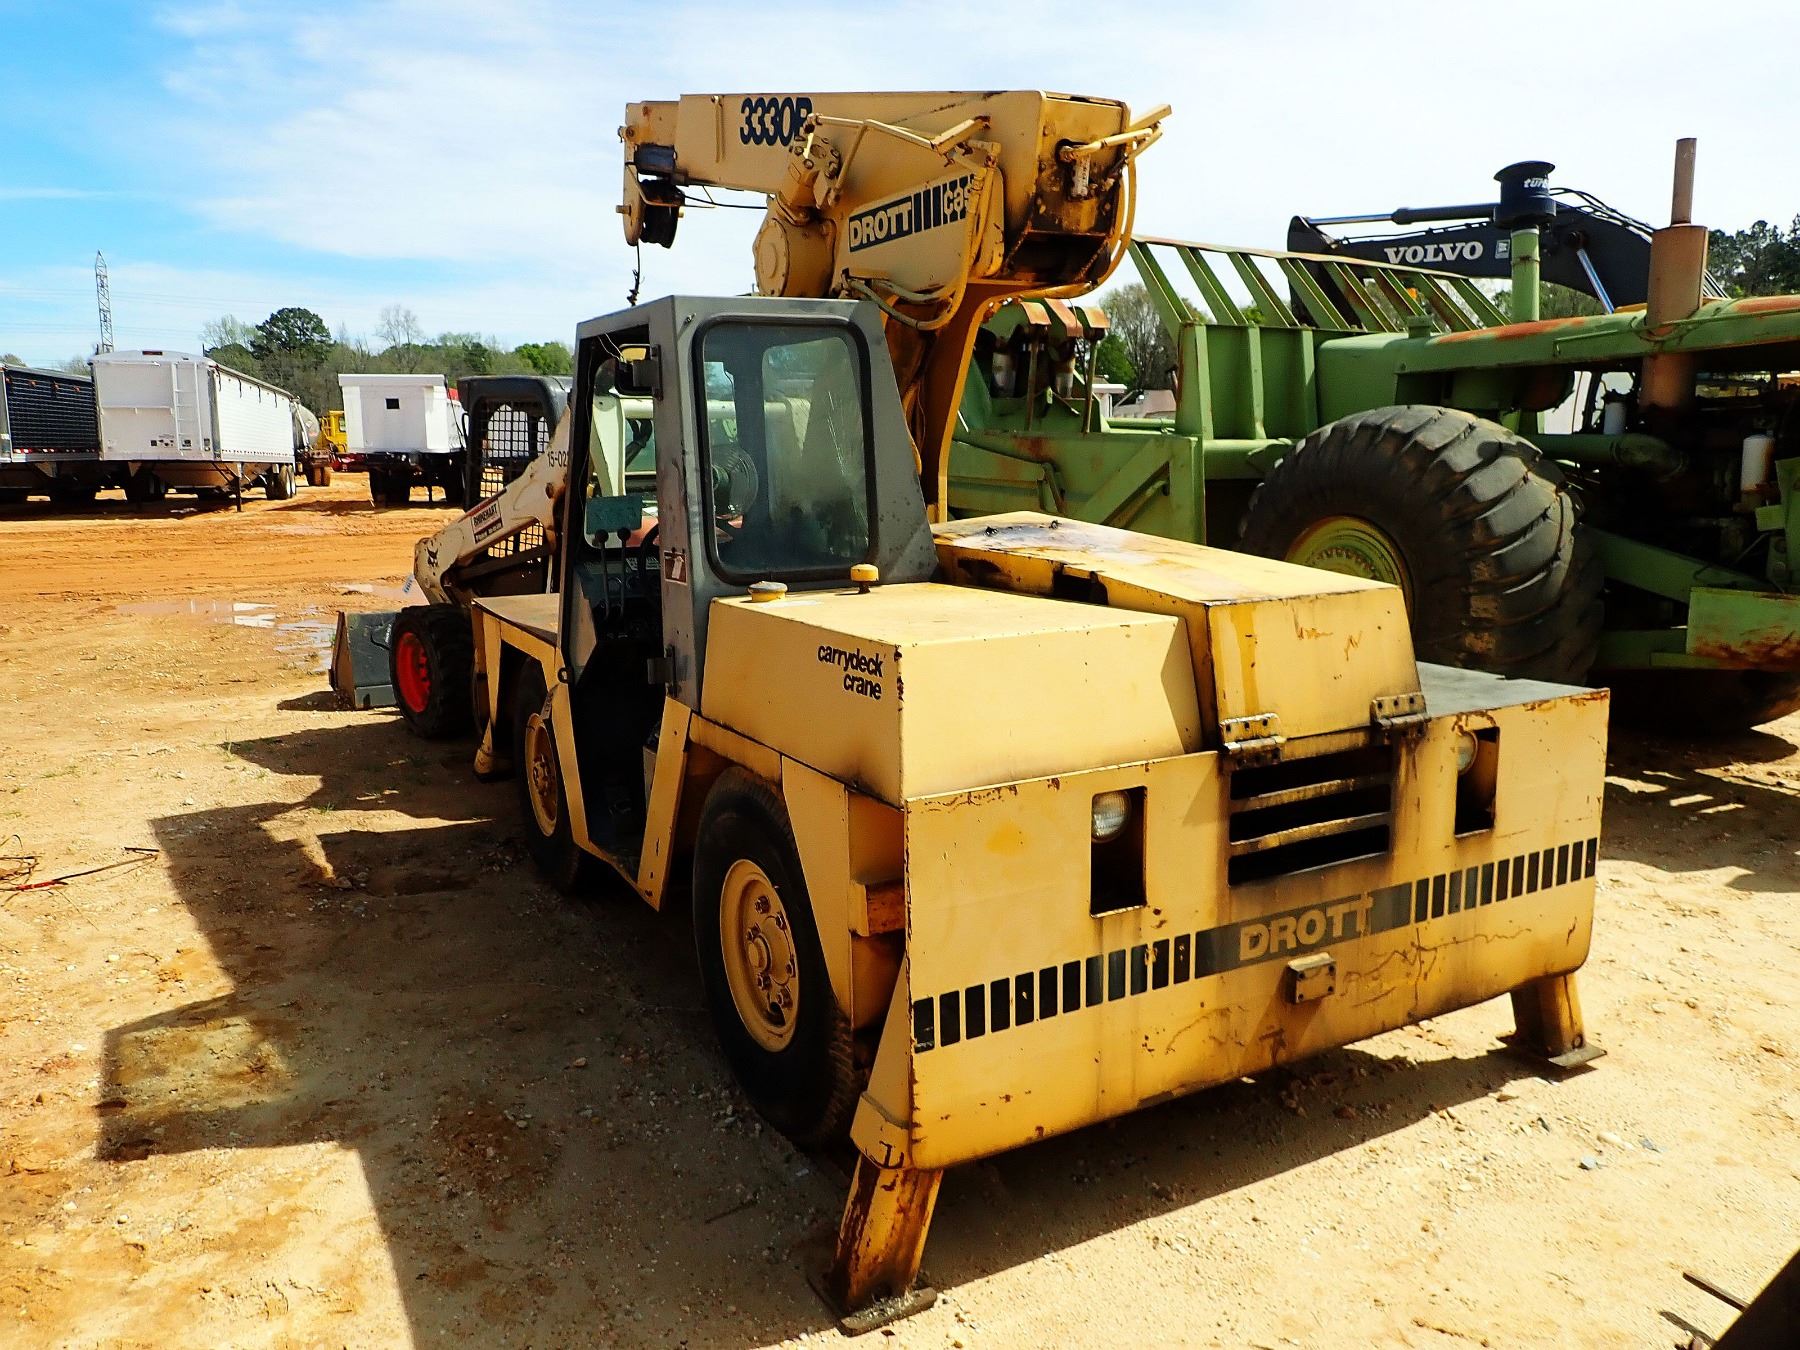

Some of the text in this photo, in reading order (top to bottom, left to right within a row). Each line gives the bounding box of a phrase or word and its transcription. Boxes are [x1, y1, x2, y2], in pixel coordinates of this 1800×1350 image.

[850, 203, 912, 247] DROTT
[1384, 241, 1484, 264] VOLVO
[817, 645, 883, 678] carrydeck
[843, 673, 882, 700] crane
[1239, 895, 1373, 961] DROTT
